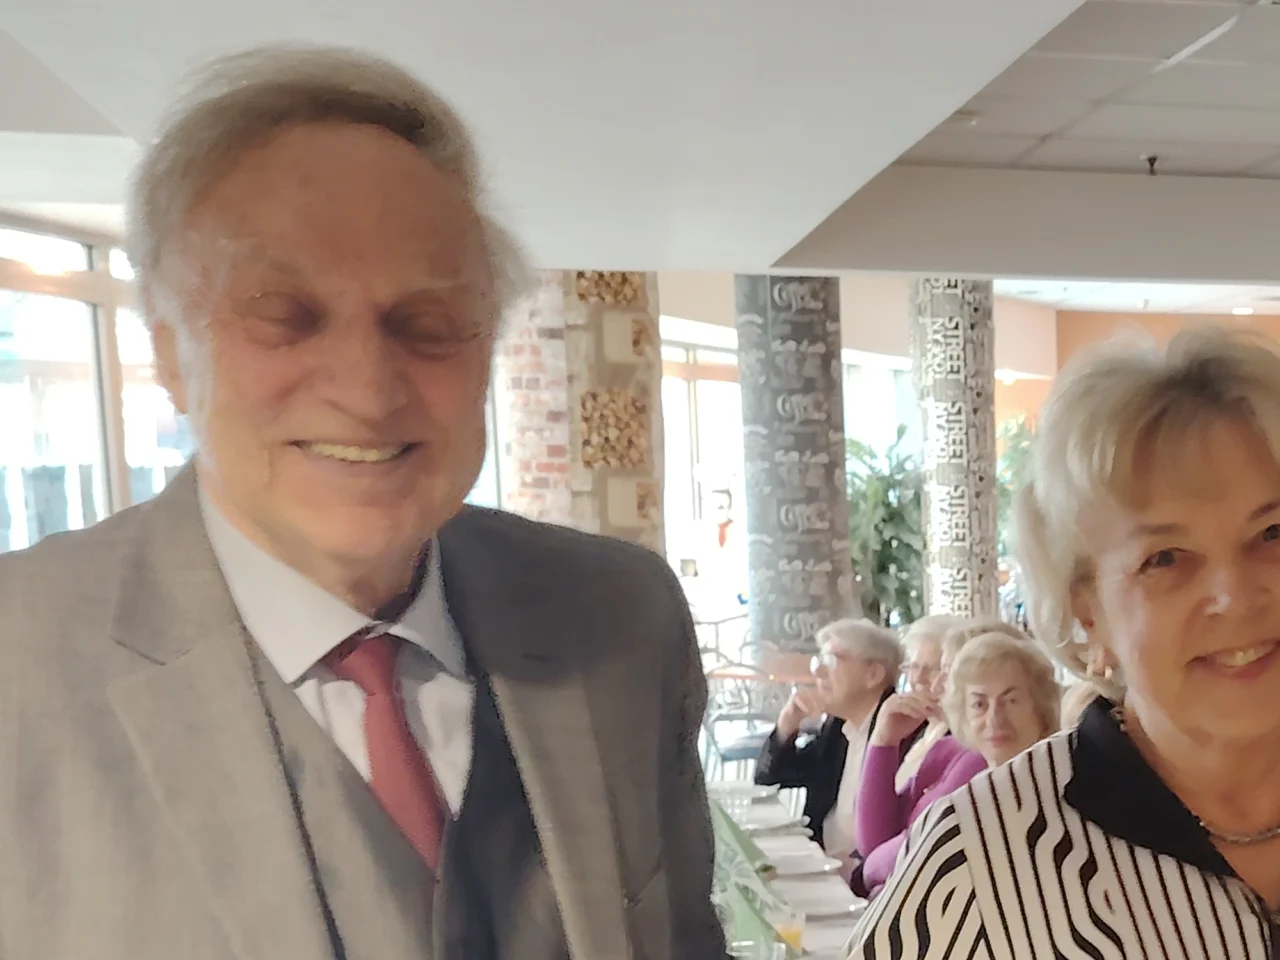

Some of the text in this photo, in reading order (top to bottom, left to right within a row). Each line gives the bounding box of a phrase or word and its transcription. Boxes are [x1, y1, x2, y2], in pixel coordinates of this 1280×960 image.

[945, 316, 966, 381] STREET
[948, 400, 968, 466] STREET
[950, 485, 970, 549] STREET
[952, 568, 973, 618] STREE
